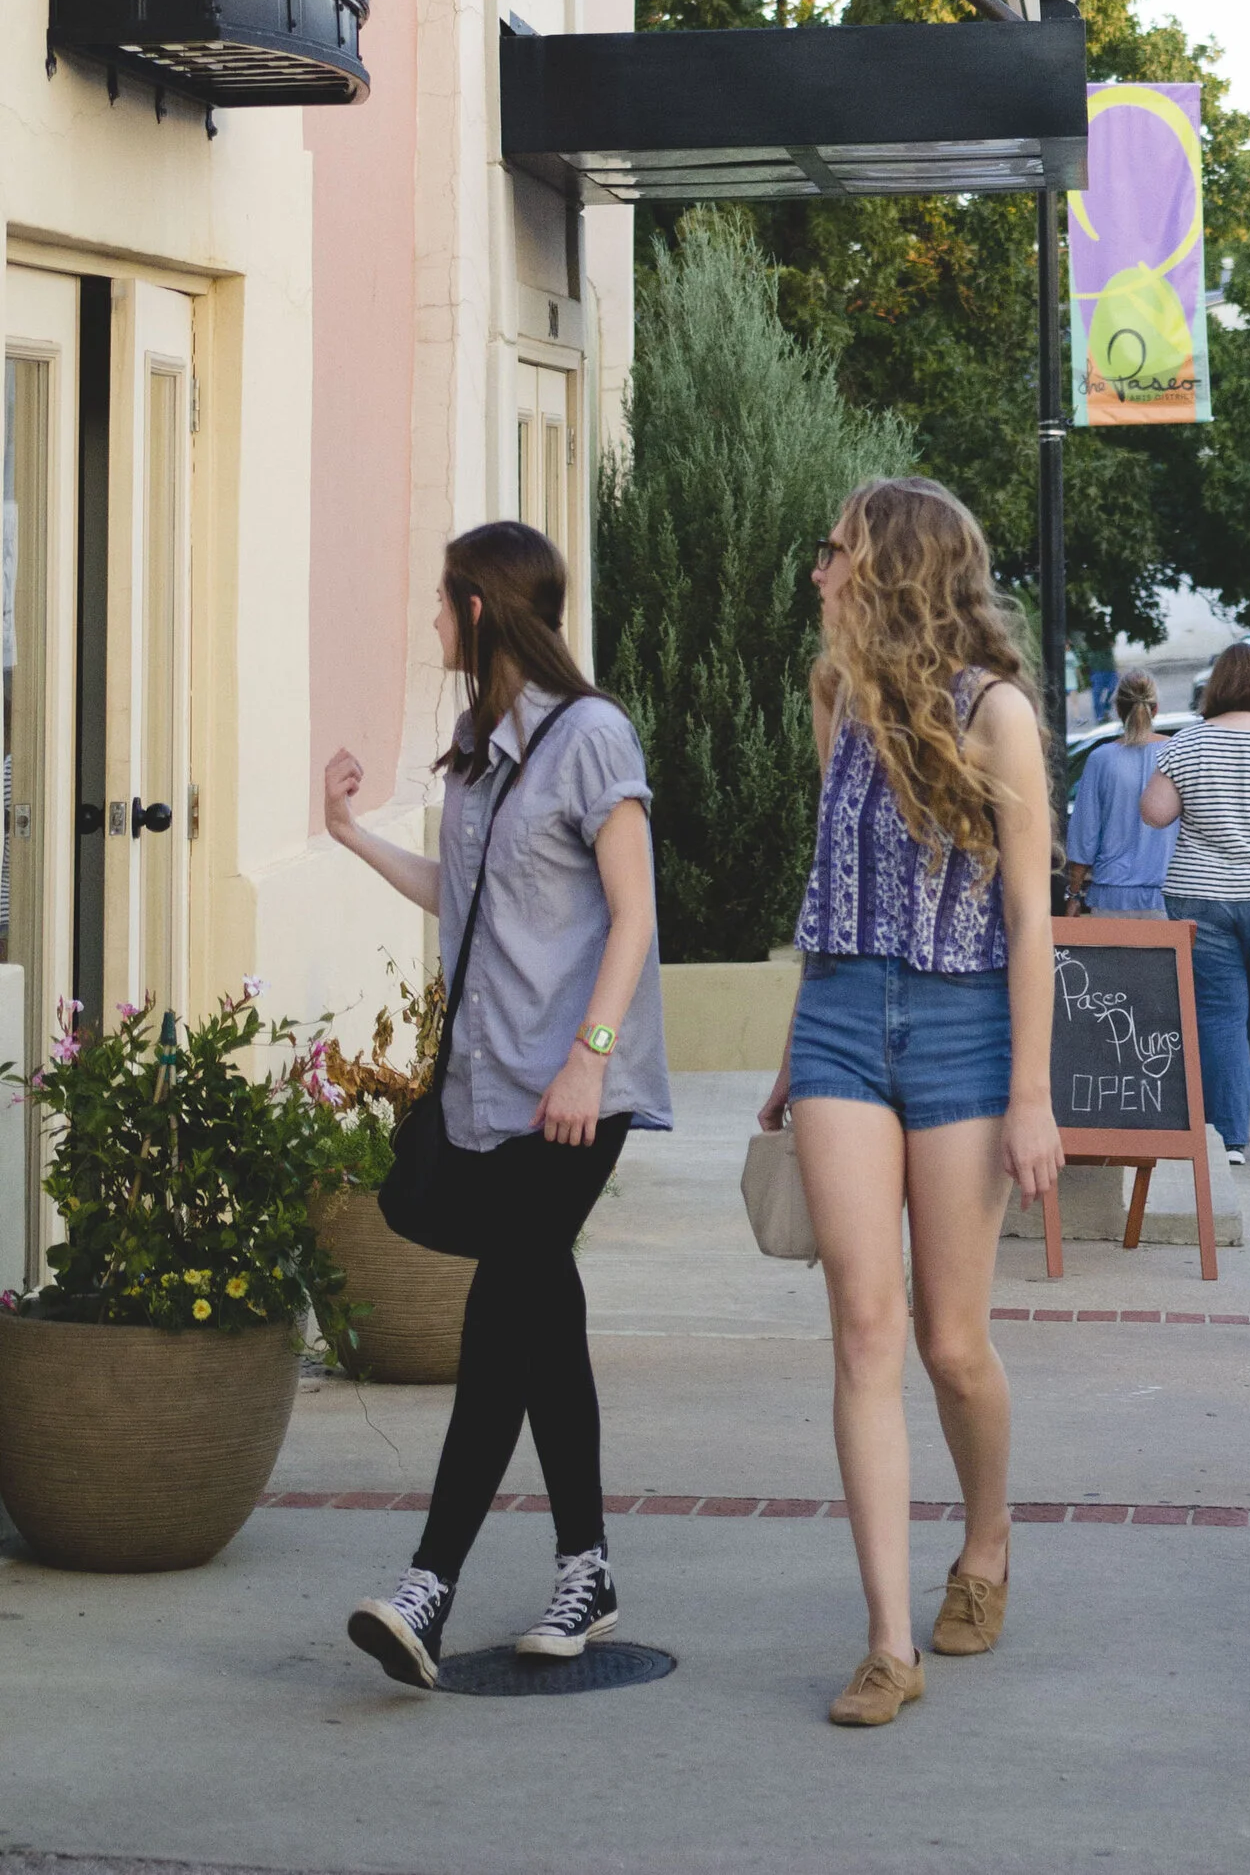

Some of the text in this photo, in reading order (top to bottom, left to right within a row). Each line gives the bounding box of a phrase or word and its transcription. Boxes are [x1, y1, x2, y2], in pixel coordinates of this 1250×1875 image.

[1095, 328, 1202, 403] Paseo
[1054, 948, 1071, 961] he
[1054, 960, 1127, 1021] Paseo
[1097, 1006, 1182, 1078] Plunge
[1072, 1074, 1161, 1112] OPEN
